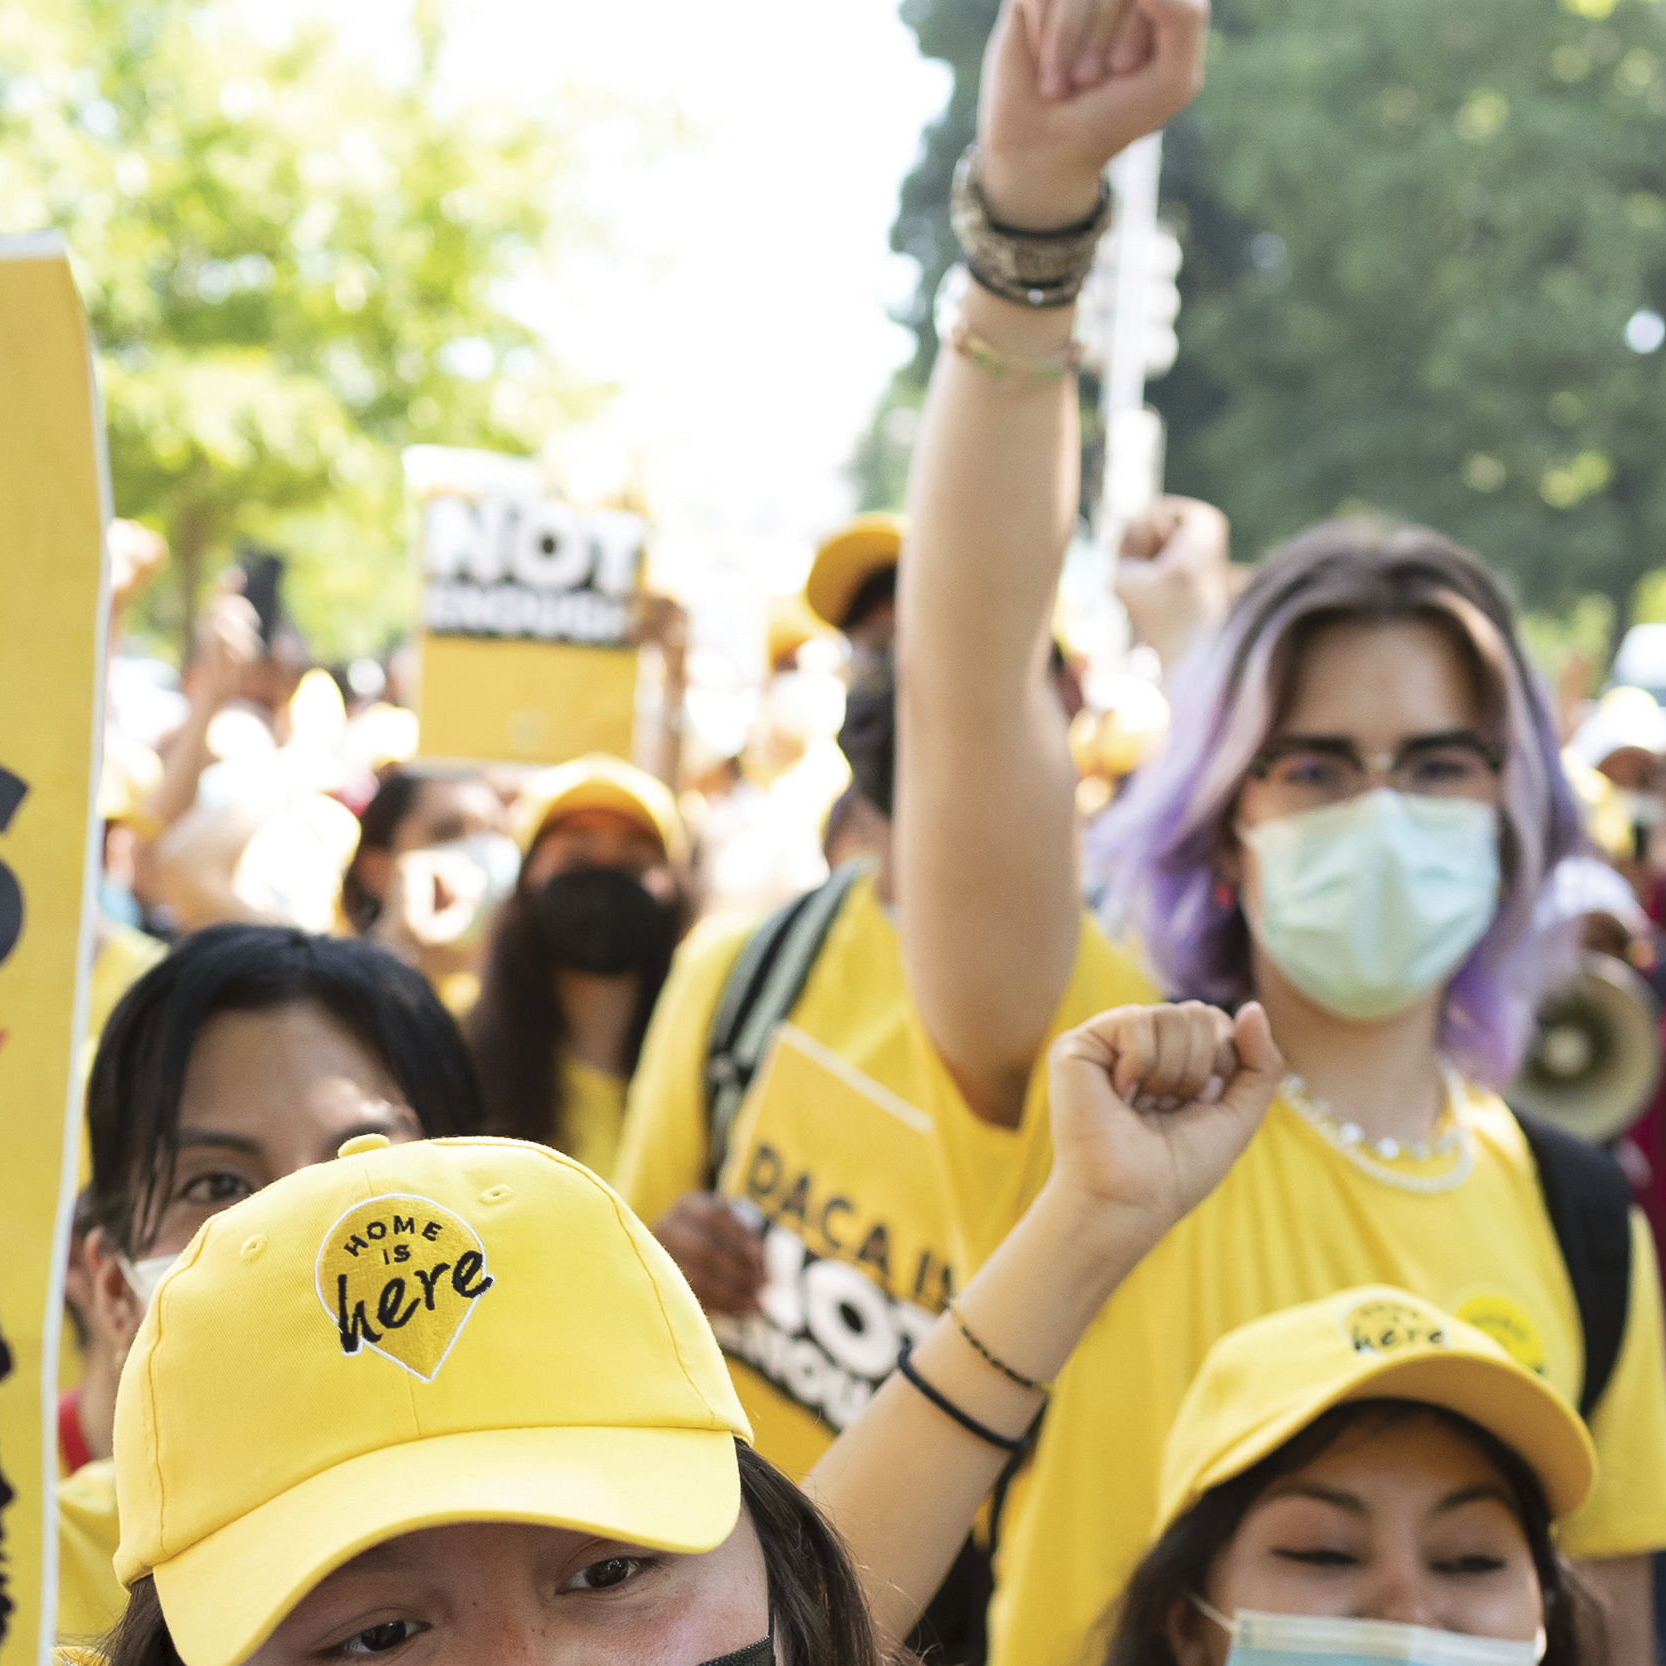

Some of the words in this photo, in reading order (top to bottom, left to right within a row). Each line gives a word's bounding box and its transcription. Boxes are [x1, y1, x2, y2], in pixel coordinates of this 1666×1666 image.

[423, 496, 646, 597] NOT
[343, 1215, 443, 1257] HOME
[383, 1244, 411, 1265] IS
[745, 1143, 893, 1282] DACA
[337, 1250, 495, 1353] here
